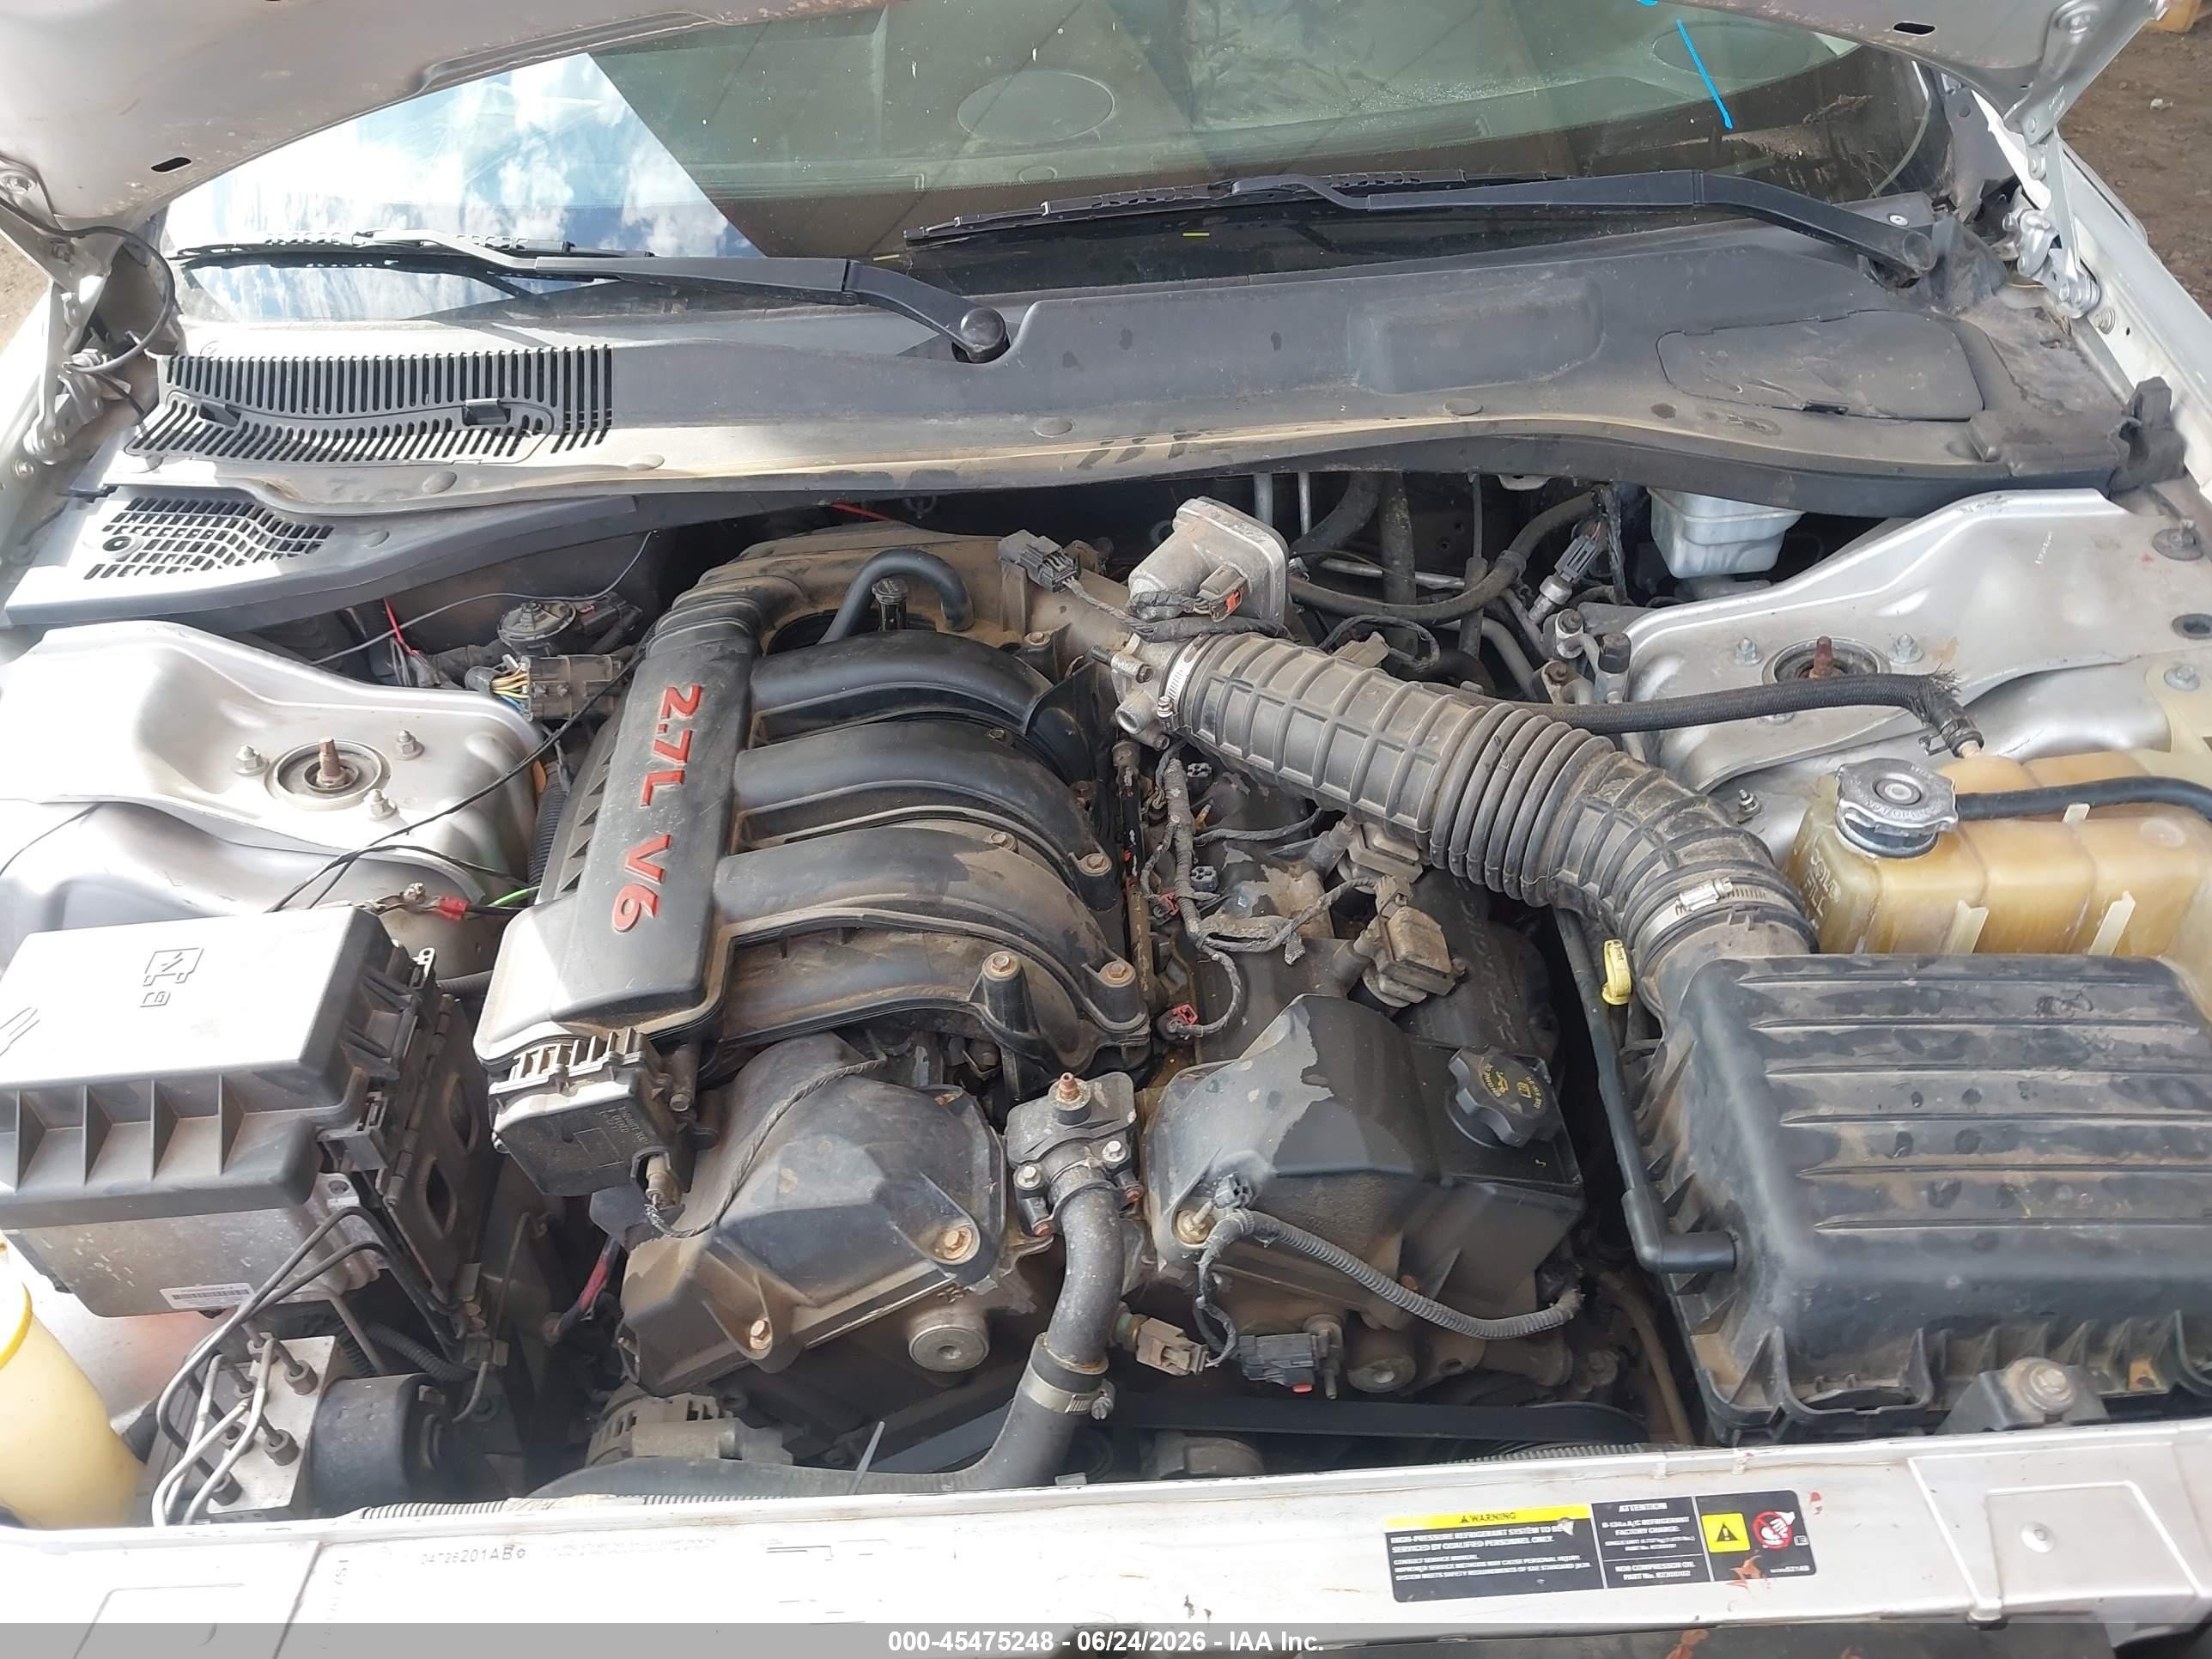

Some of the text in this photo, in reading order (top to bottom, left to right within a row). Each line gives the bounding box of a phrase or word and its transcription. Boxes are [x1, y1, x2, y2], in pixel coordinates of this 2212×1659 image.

[611, 683, 703, 934] 2.7L V6
[1810, 848, 1842, 904] COLD
[1470, 1512, 1516, 1522] WARNING
